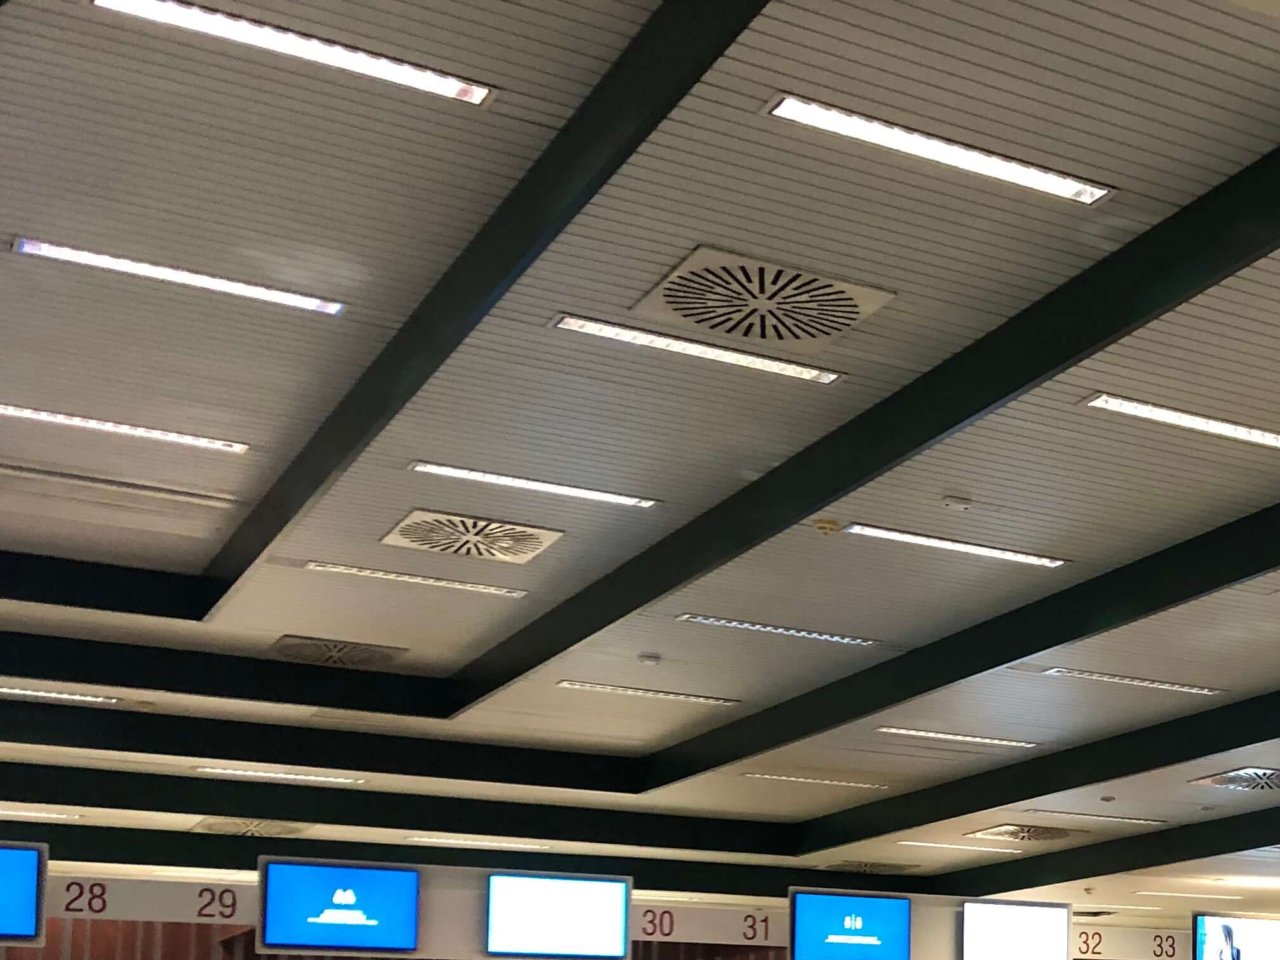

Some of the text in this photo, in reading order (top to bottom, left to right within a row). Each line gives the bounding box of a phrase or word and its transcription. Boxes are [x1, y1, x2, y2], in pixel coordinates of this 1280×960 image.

[64, 882, 107, 914] 28
[197, 887, 238, 918] 29
[641, 909, 675, 937] 30
[742, 914, 770, 941] 31
[1078, 931, 1102, 955] 32
[1152, 935, 1176, 958] 33
